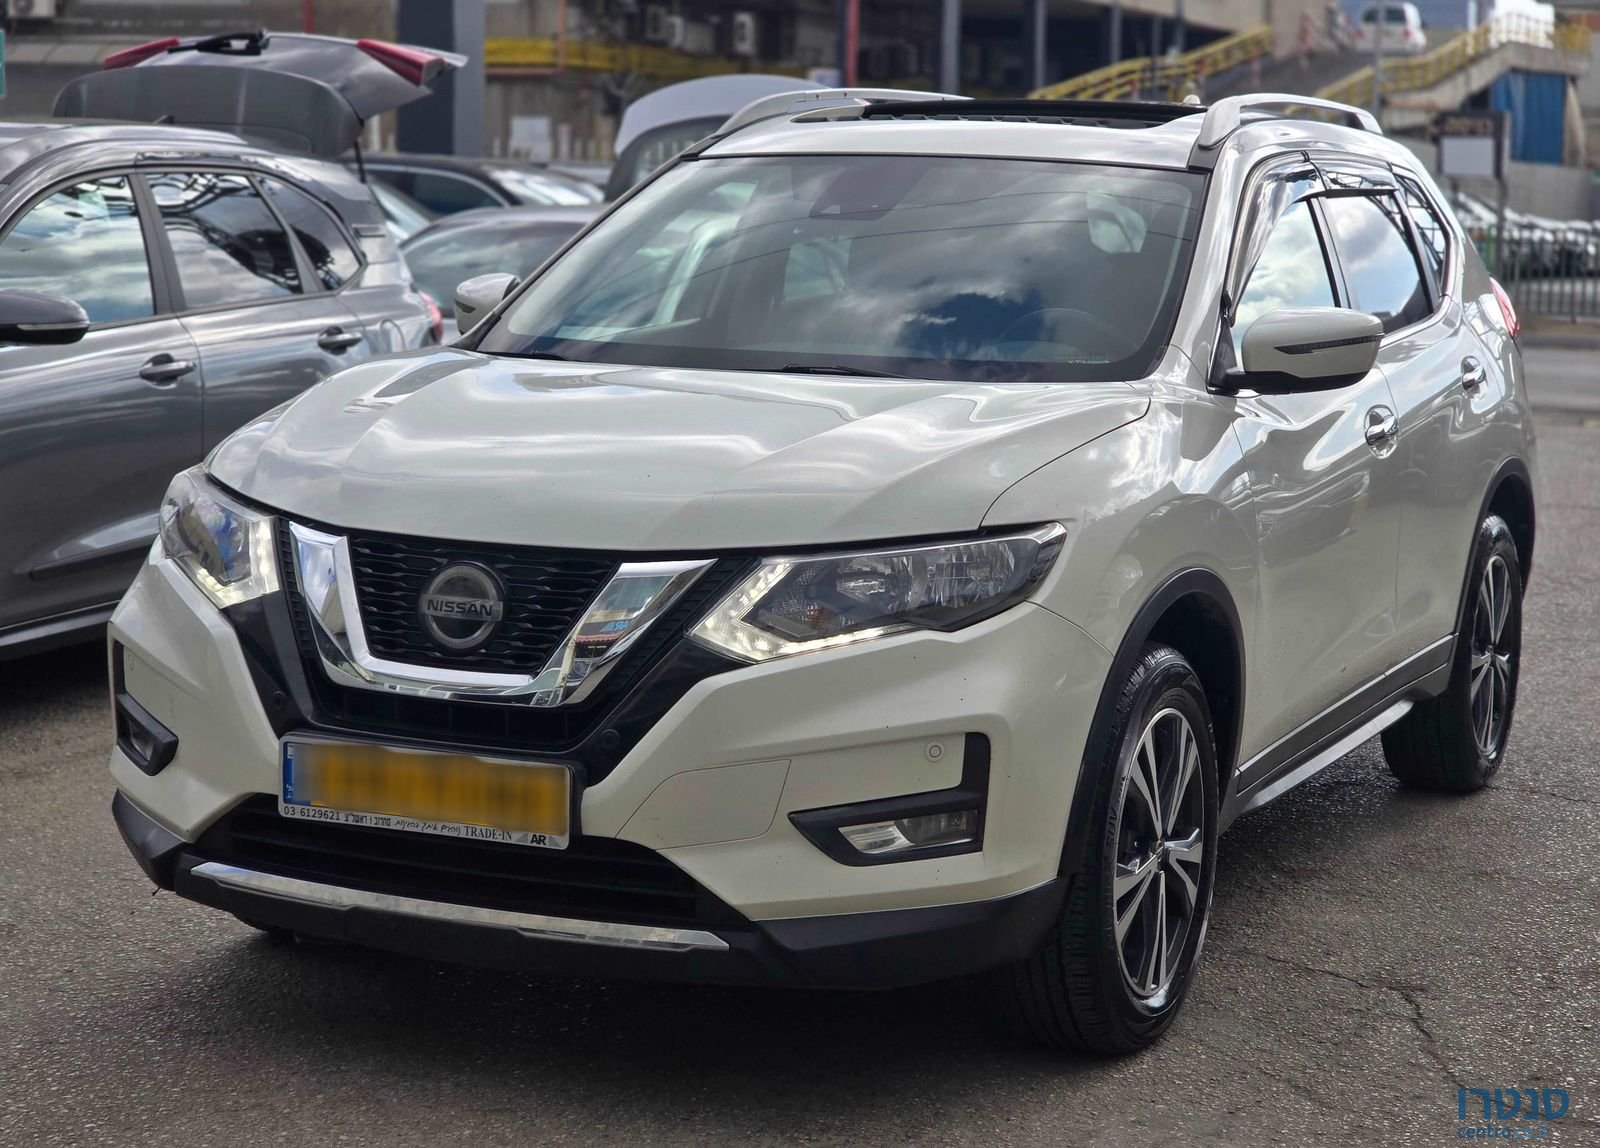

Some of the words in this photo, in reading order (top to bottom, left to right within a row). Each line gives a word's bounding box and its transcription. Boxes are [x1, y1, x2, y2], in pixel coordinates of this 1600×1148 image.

[427, 599, 493, 617] NISSAN
[464, 825, 512, 841] TRADE-IN
[530, 834, 547, 846] AR
